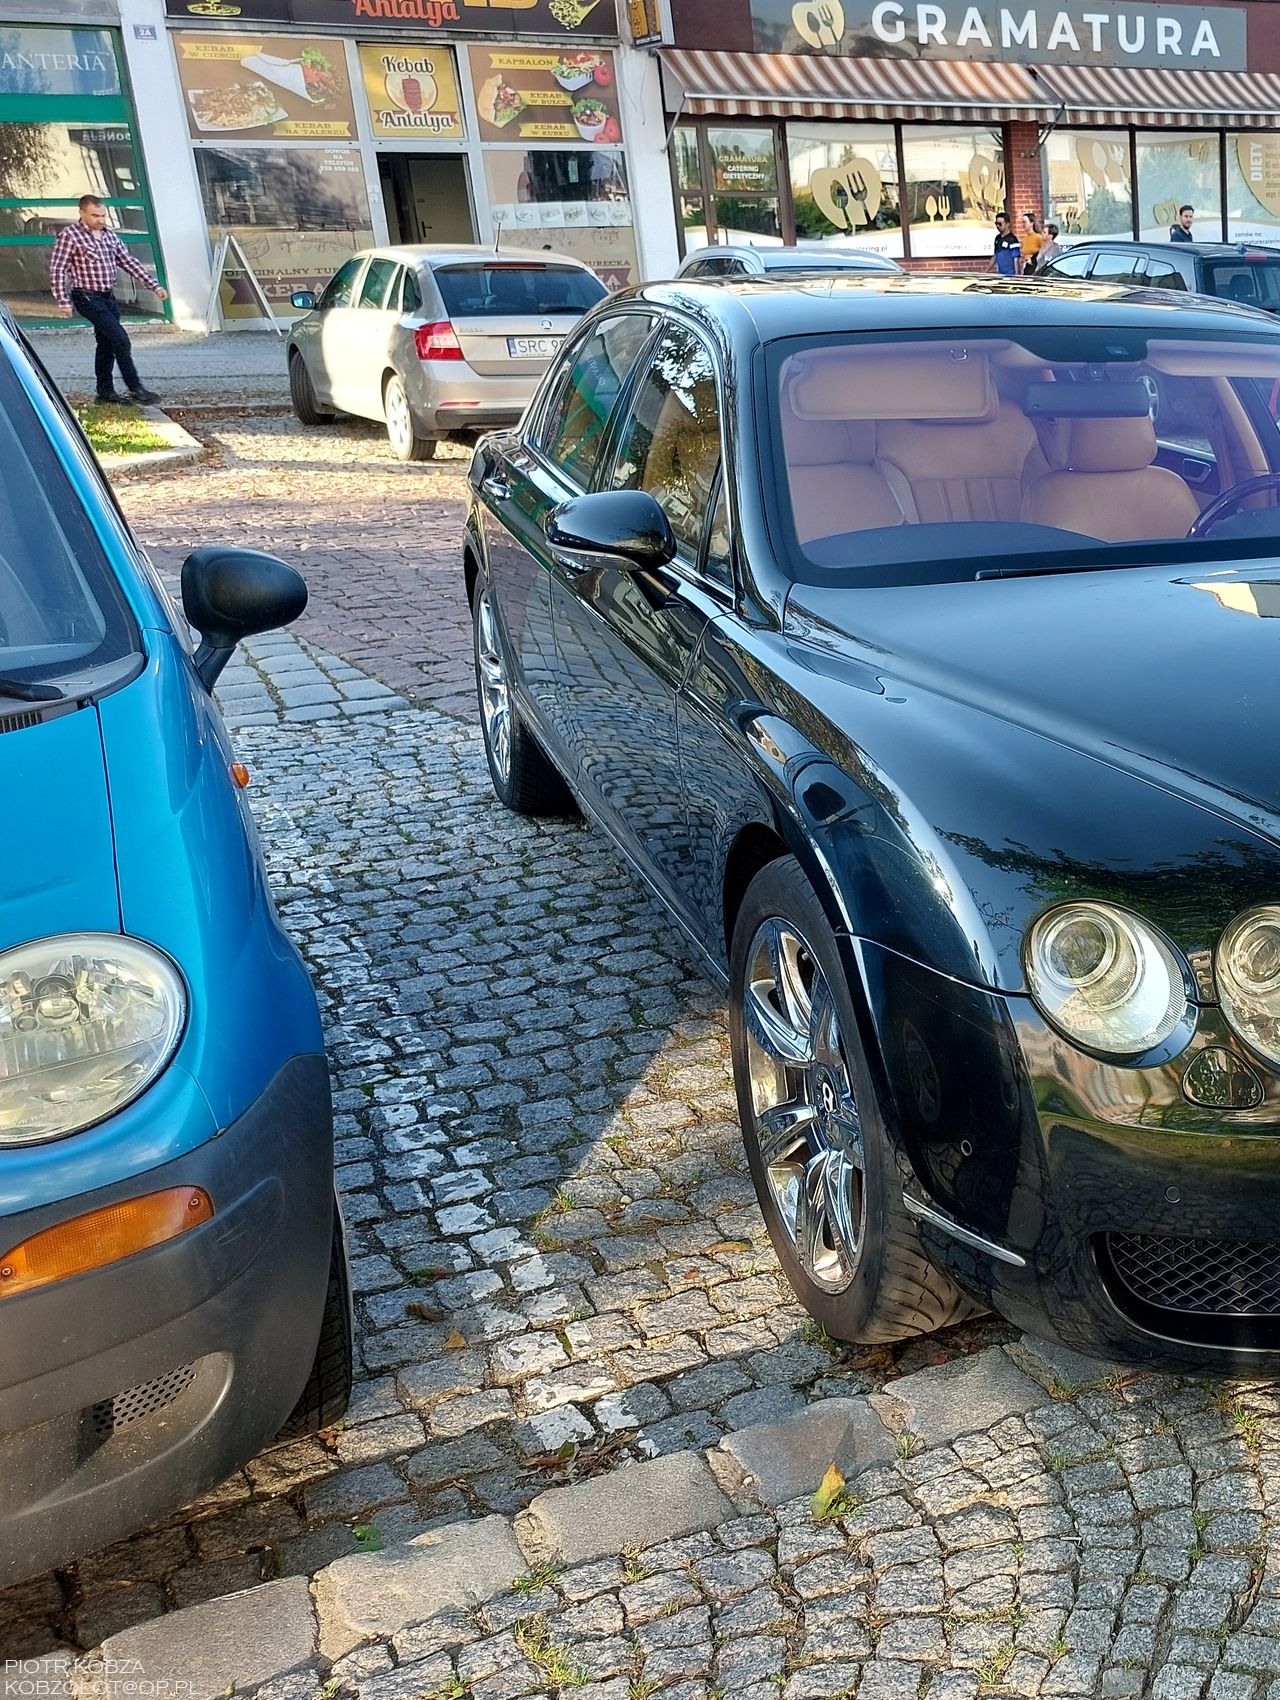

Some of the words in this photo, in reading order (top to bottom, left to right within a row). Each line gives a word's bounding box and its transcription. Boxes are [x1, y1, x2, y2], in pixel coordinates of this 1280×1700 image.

[871, 1, 1222, 57] GRAMATURA
[381, 56, 434, 74] Kebab
[498, 58, 553, 66] KAPSALON
[380, 111, 453, 133] Antalya
[1250, 142, 1263, 181] DIETY
[517, 341, 547, 353] SRC
